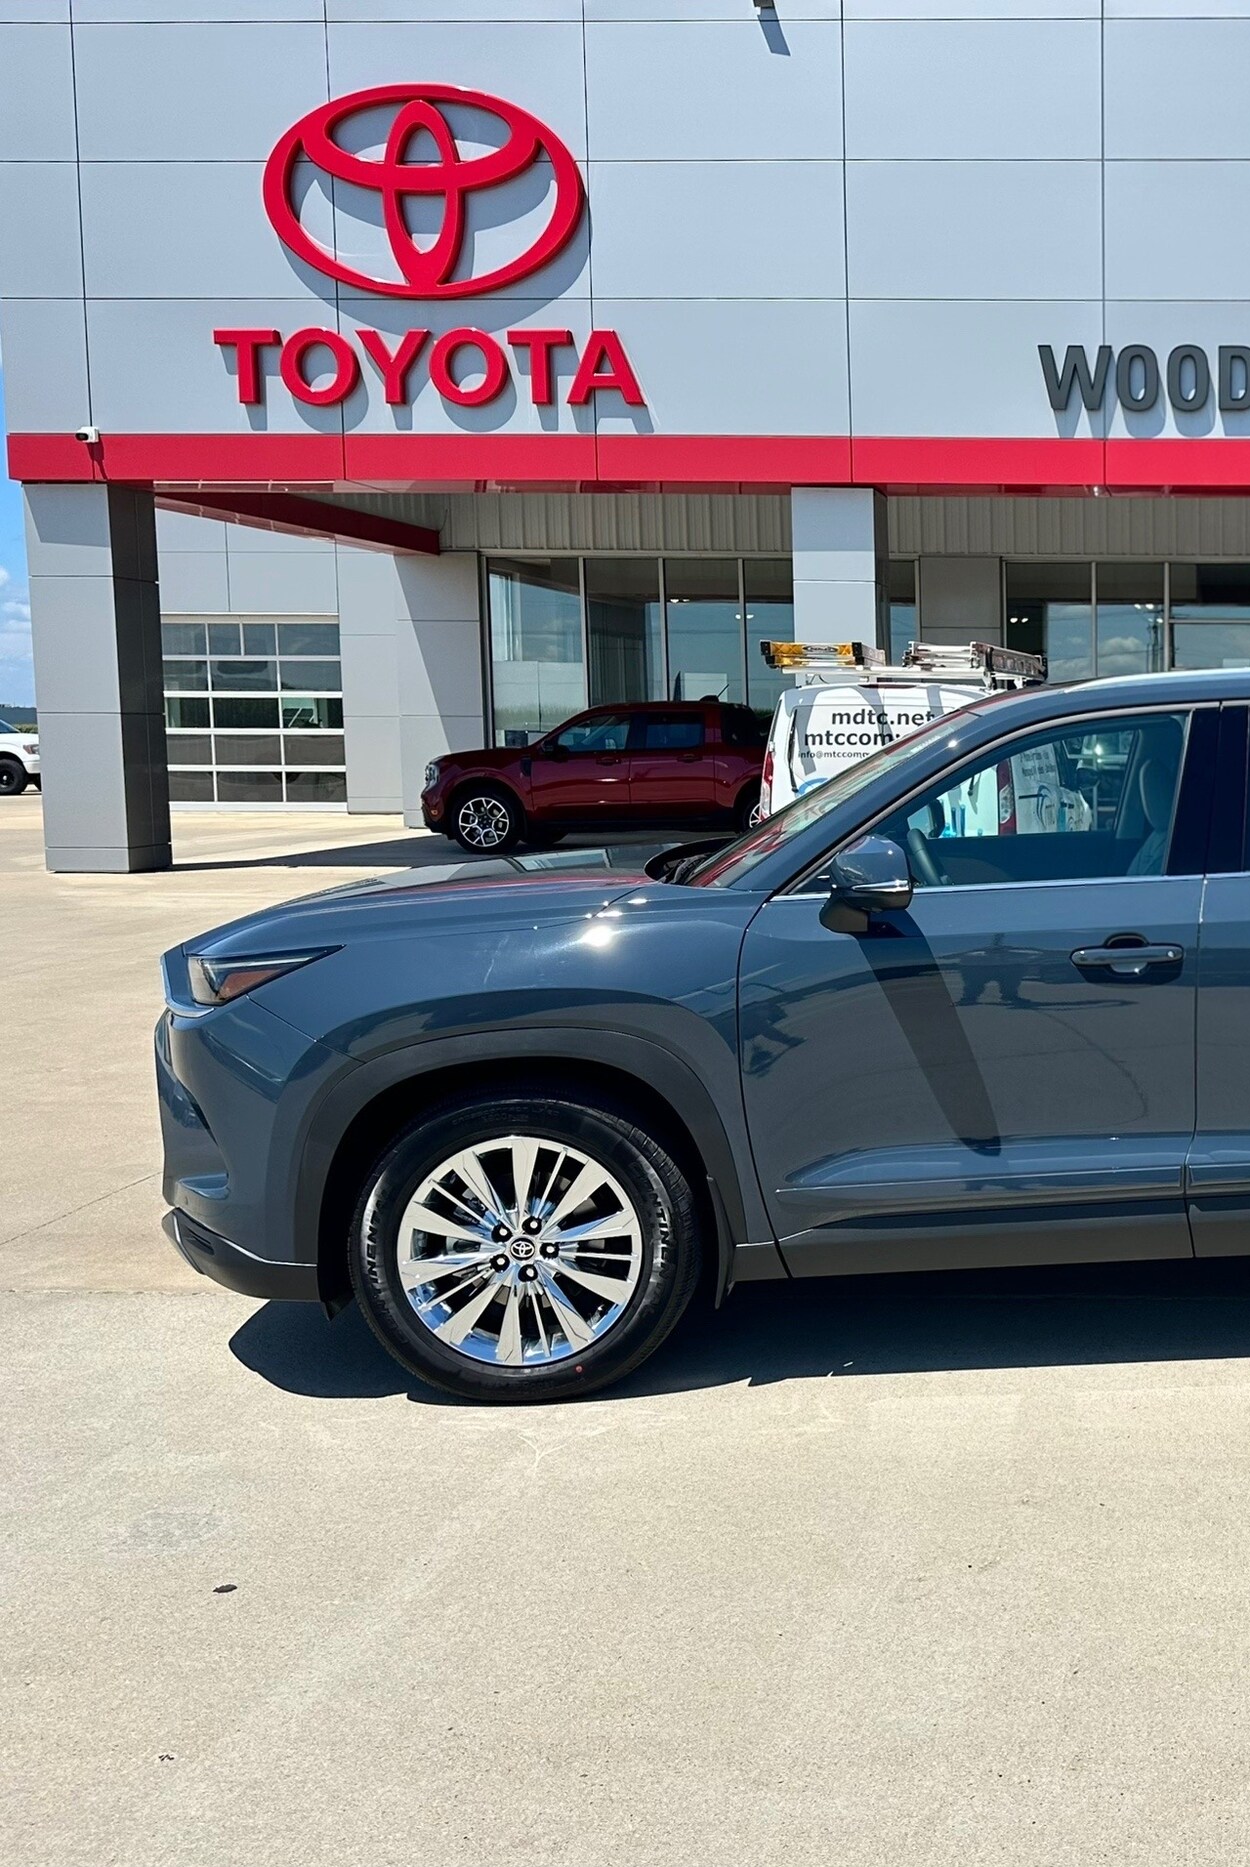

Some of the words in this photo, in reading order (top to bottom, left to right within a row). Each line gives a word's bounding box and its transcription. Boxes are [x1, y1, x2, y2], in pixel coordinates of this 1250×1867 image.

[213, 327, 648, 406] TOYOTA
[832, 708, 935, 726] mdtc.net
[804, 730, 900, 746] mtccom
